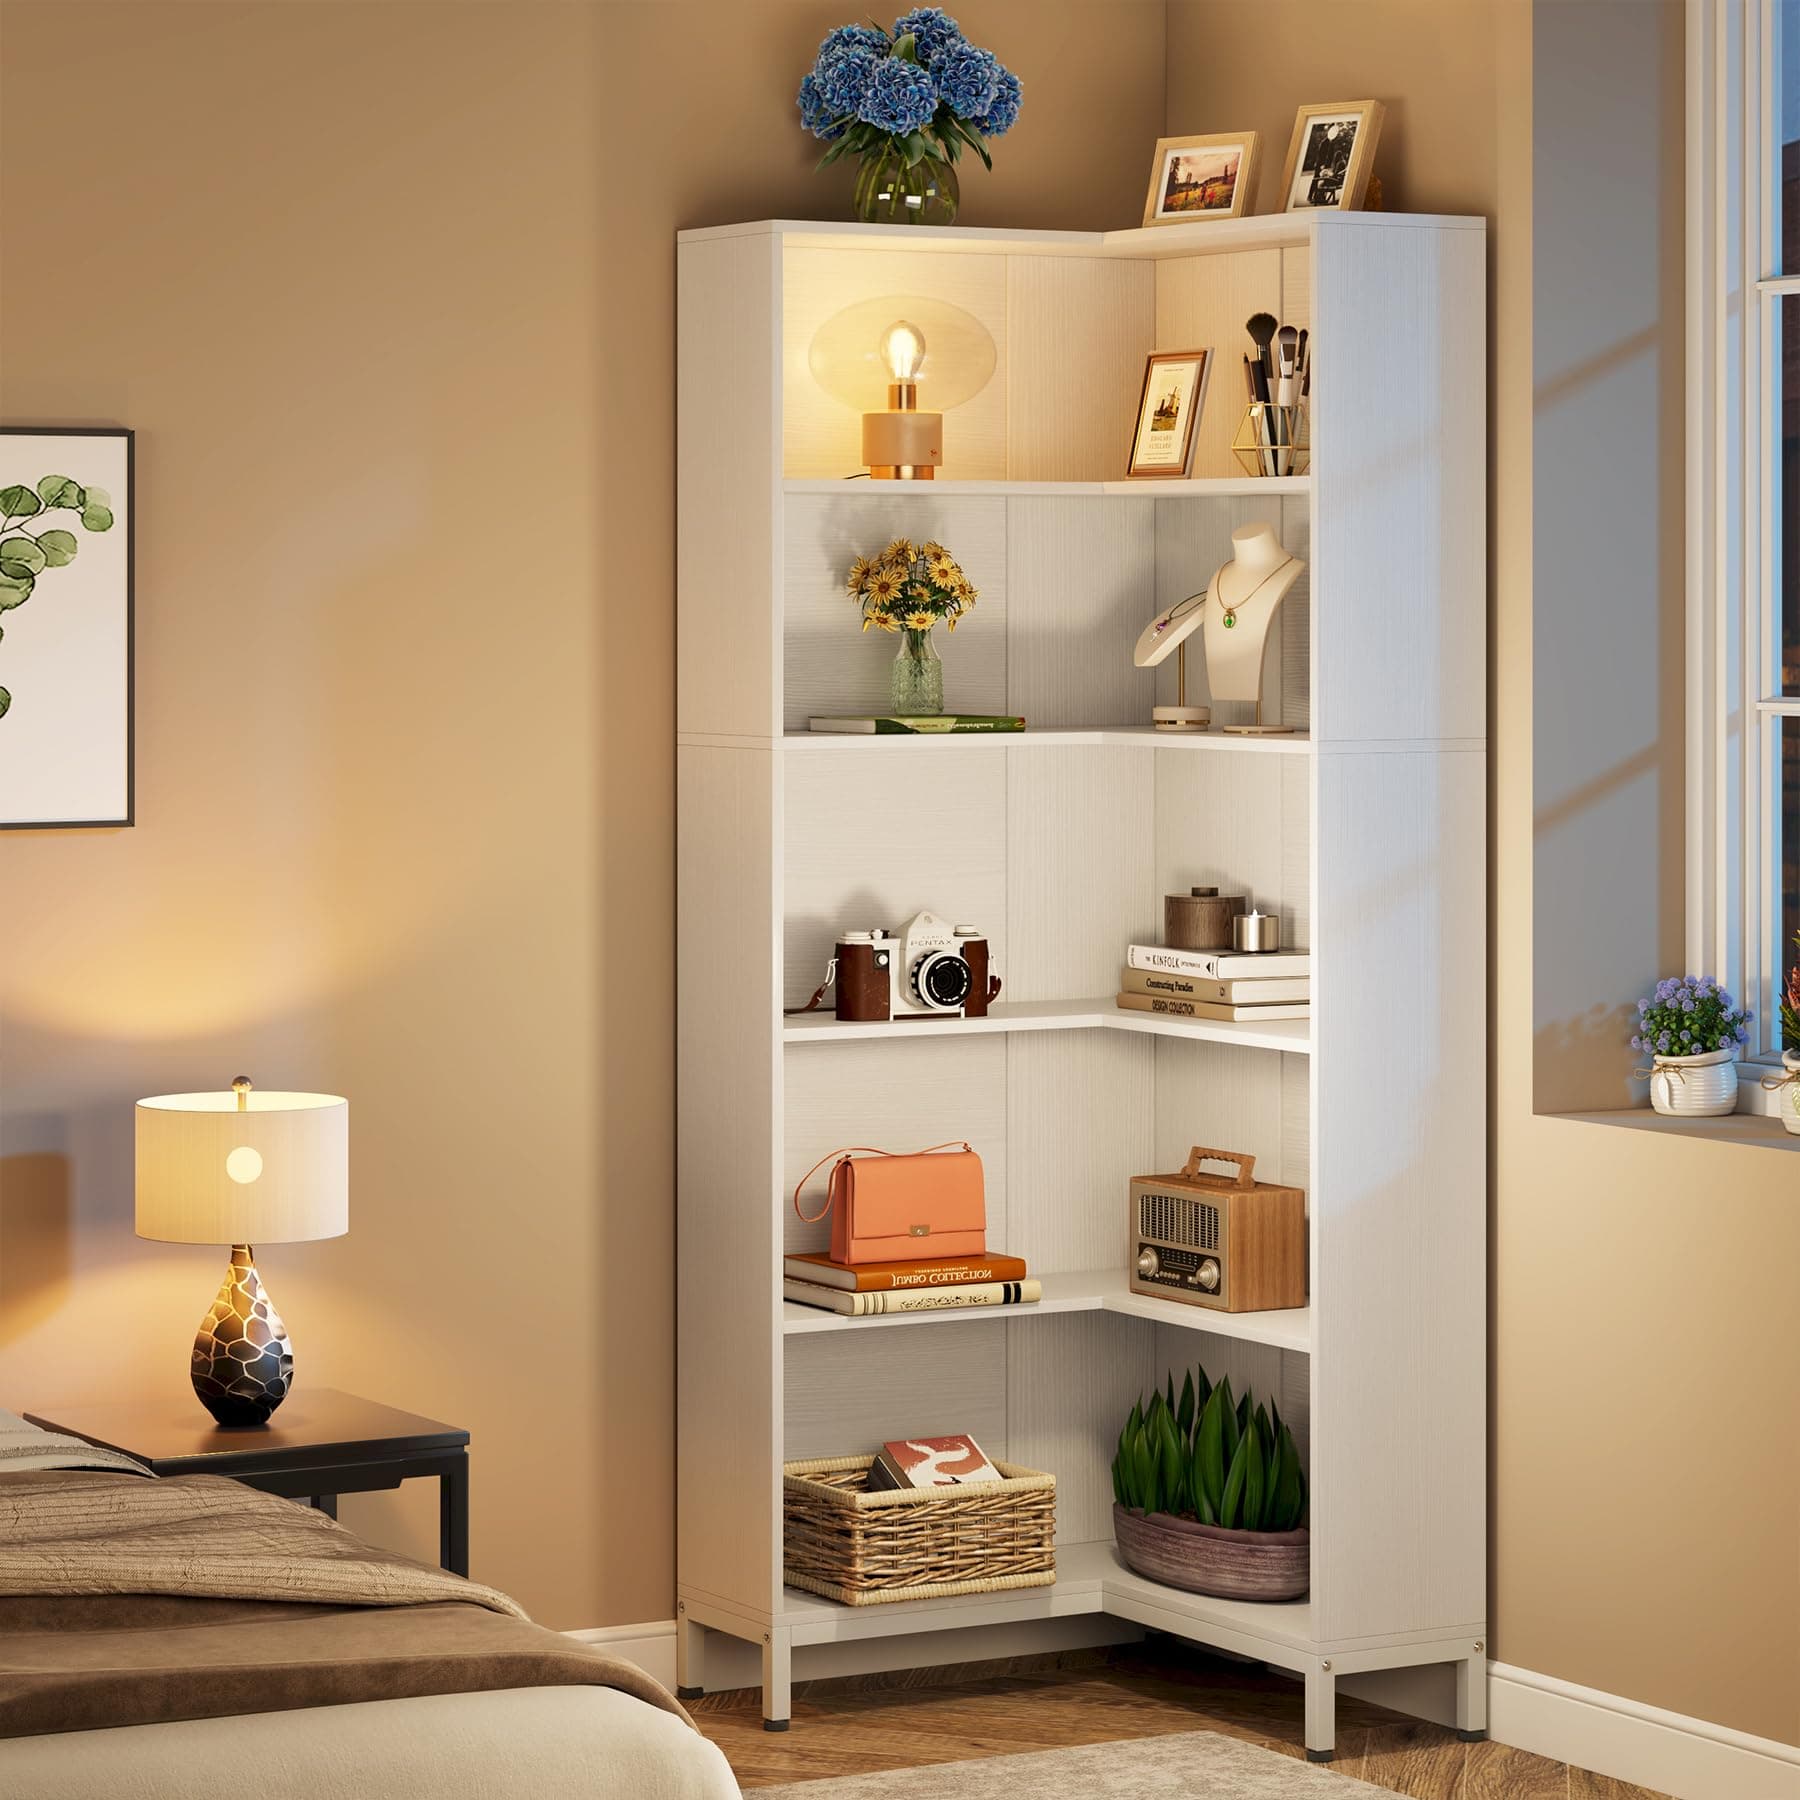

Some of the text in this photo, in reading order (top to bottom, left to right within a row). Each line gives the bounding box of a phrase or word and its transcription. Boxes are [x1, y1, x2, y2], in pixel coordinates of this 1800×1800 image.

[1152, 954, 1180, 968] KINFOLK
[1152, 999, 1195, 1015] DESIGN COLLECTION
